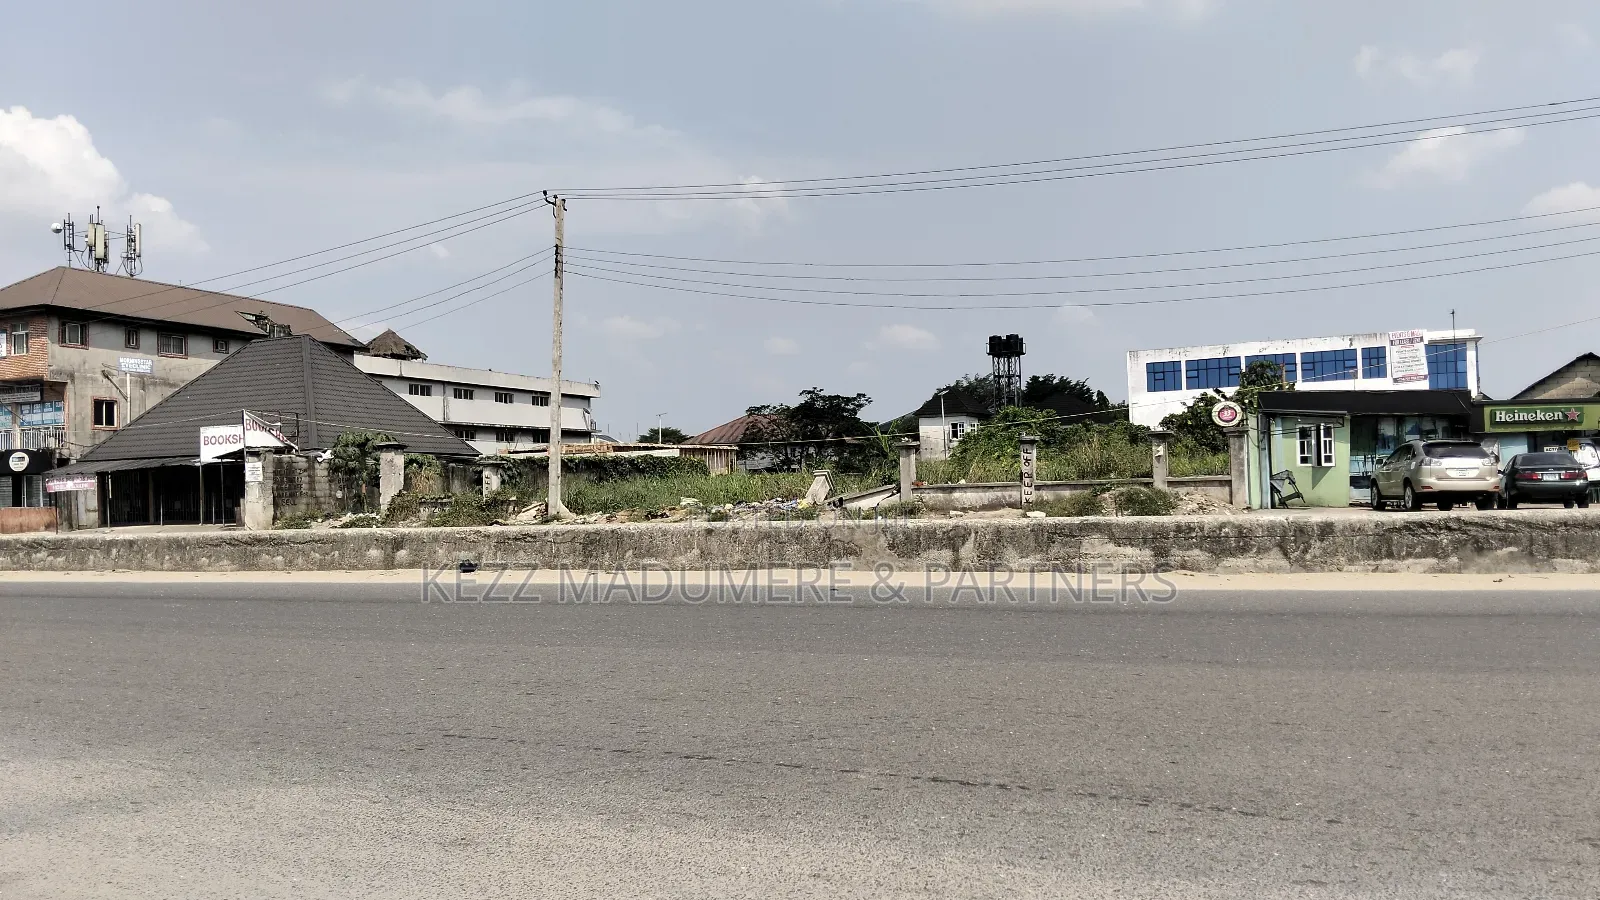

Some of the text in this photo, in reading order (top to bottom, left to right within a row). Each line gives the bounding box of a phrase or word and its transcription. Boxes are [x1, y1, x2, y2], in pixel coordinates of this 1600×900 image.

[1495, 410, 1564, 422] Heineken
[203, 434, 244, 446] BOOKSH
[1023, 470, 1033, 504] KEEP
